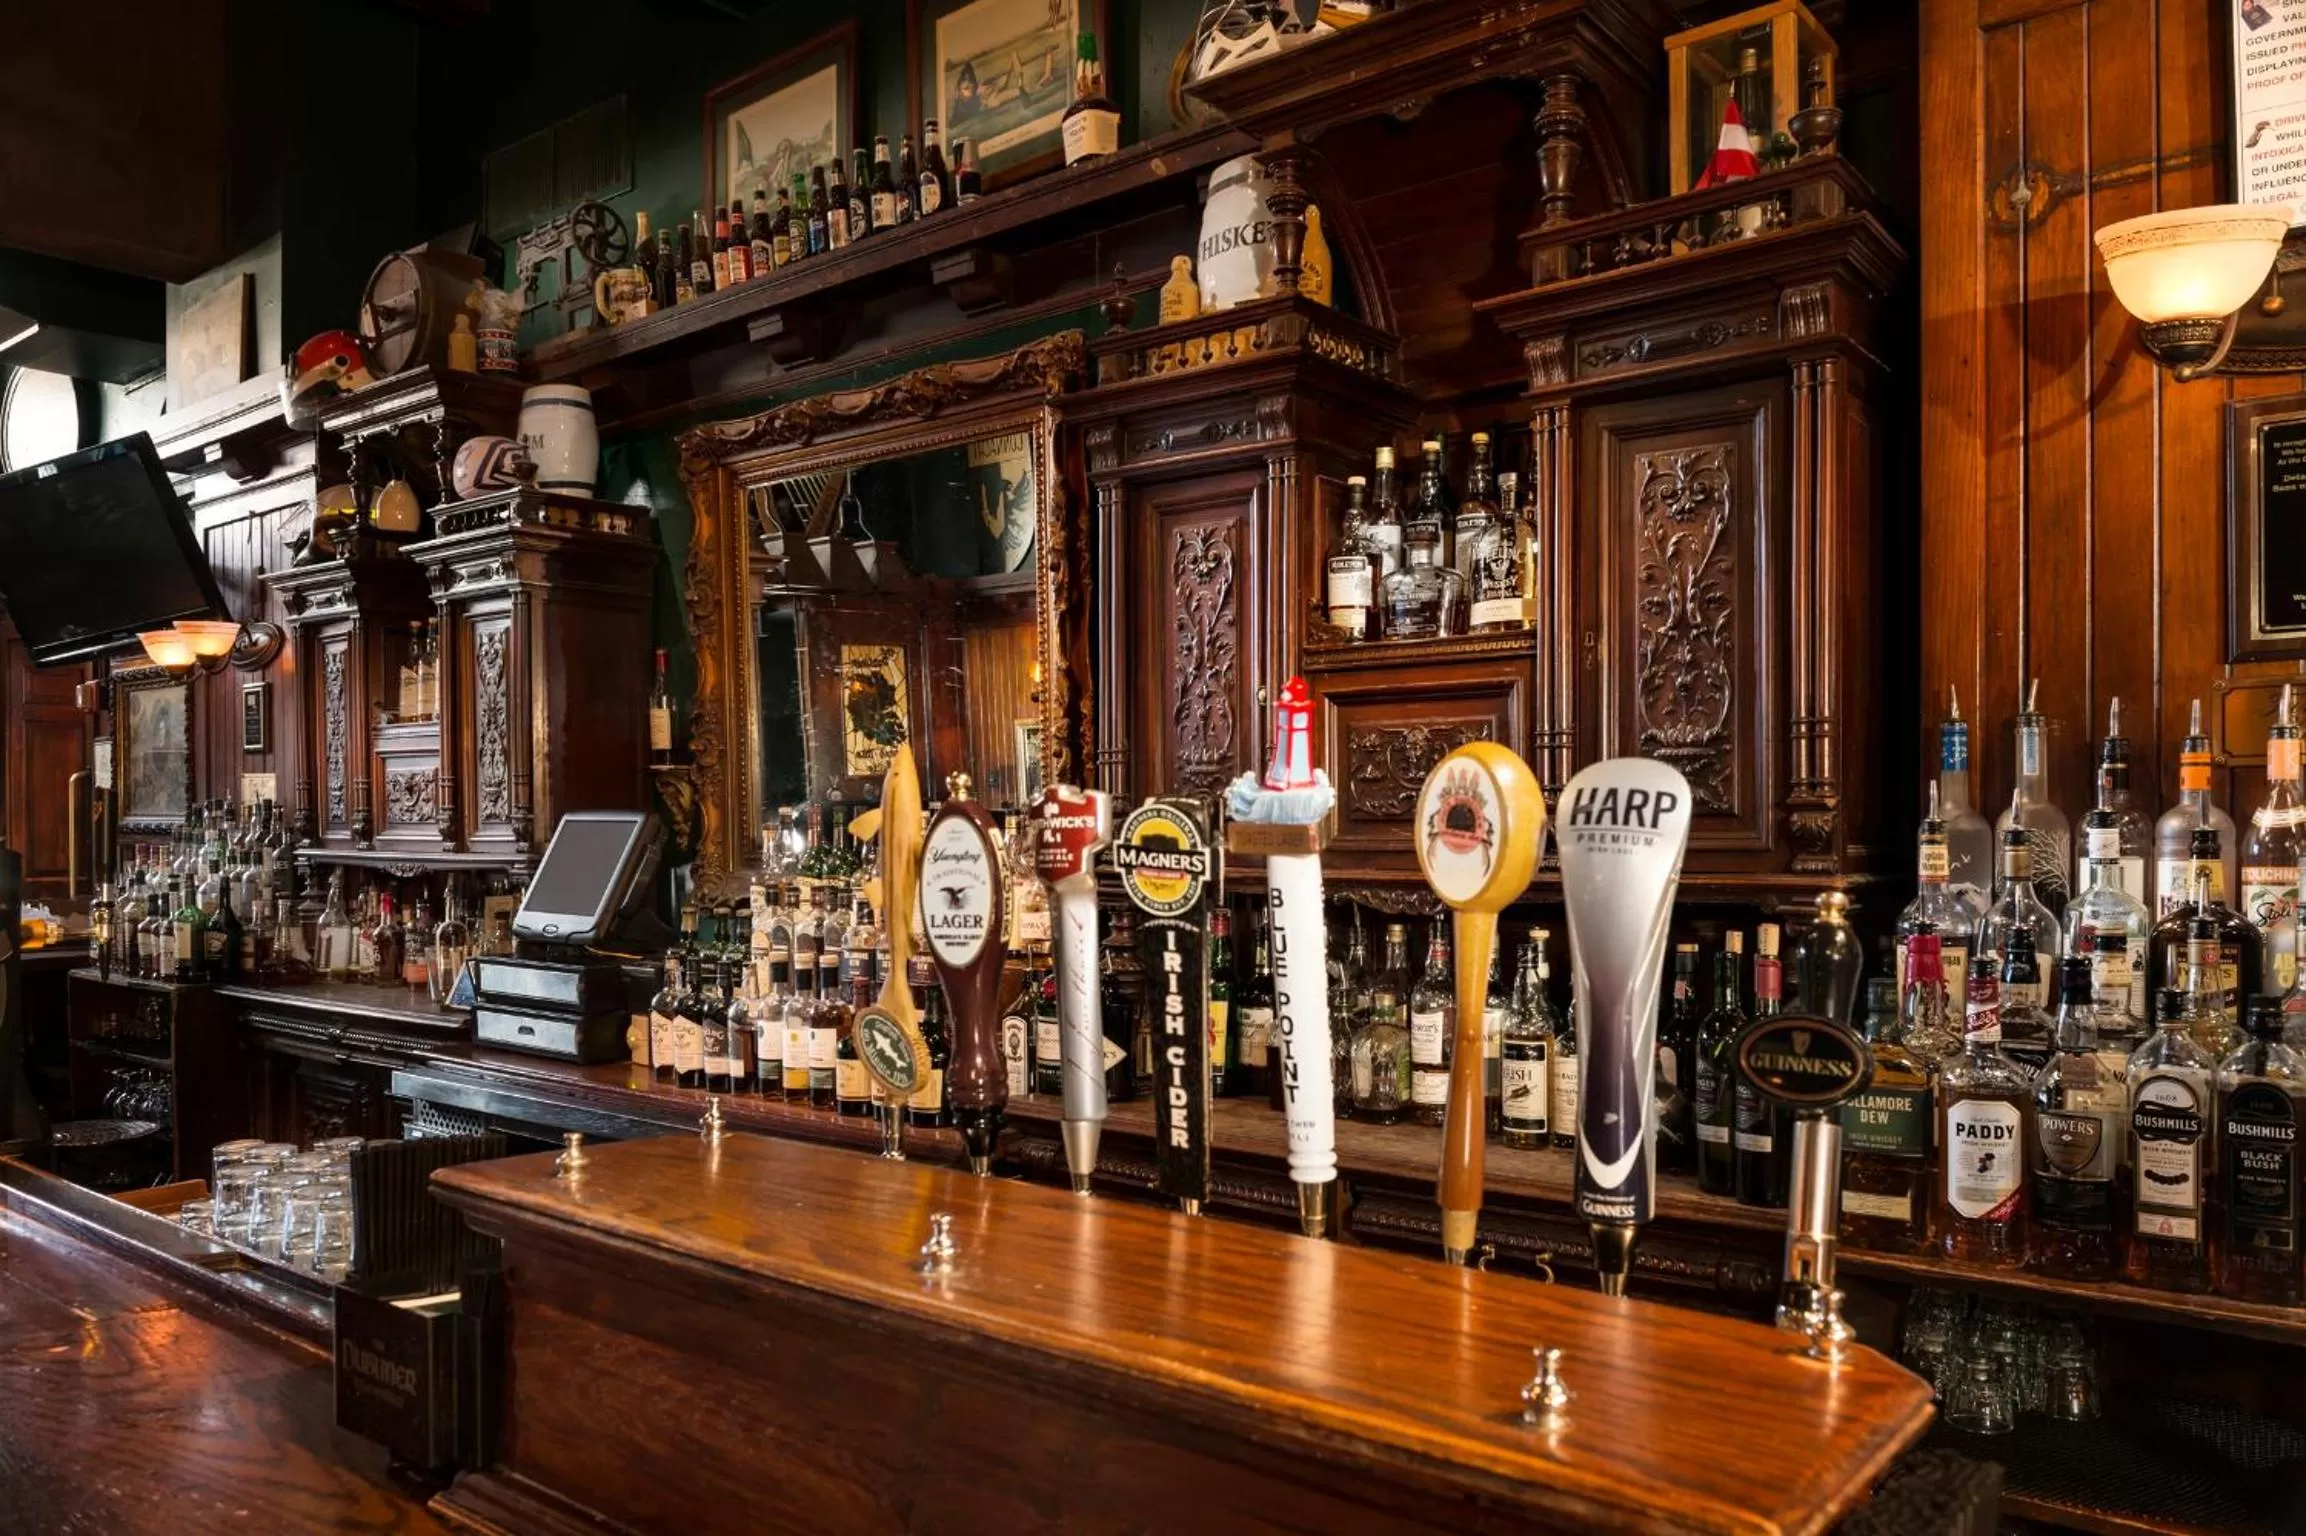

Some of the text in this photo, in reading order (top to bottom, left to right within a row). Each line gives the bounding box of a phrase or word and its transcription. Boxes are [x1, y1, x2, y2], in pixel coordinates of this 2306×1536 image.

[2246, 45, 2288, 61] ISSUED
[2247, 75, 2286, 90] PROOF
[2252, 166, 2268, 176] OR
[1200, 221, 1272, 262] HISKE
[1570, 786, 1678, 831] HARP
[1577, 832, 1655, 847] PREMIUM
[1119, 849, 1203, 873] MAGNERS
[930, 914, 983, 929] LAGER
[2257, 901, 2290, 927] Stoli
[1270, 888, 1300, 1104] BLUE POINT
[1163, 930, 1189, 1149] IRISH CIDER
[1751, 1053, 1853, 1077] GUINNESS
[1860, 1110, 1889, 1125] DEW
[2042, 1117, 2094, 1136] POWERS
[2135, 1114, 2198, 1132] BUSHMILLS
[1956, 1121, 2015, 1140] PADDY
[2228, 1121, 2296, 1140] BUSHMILLS
[2240, 1151, 2283, 1163] BLACK
[2243, 1159, 2280, 1170] BUSH
[1583, 1199, 1636, 1218] GUINNESS
